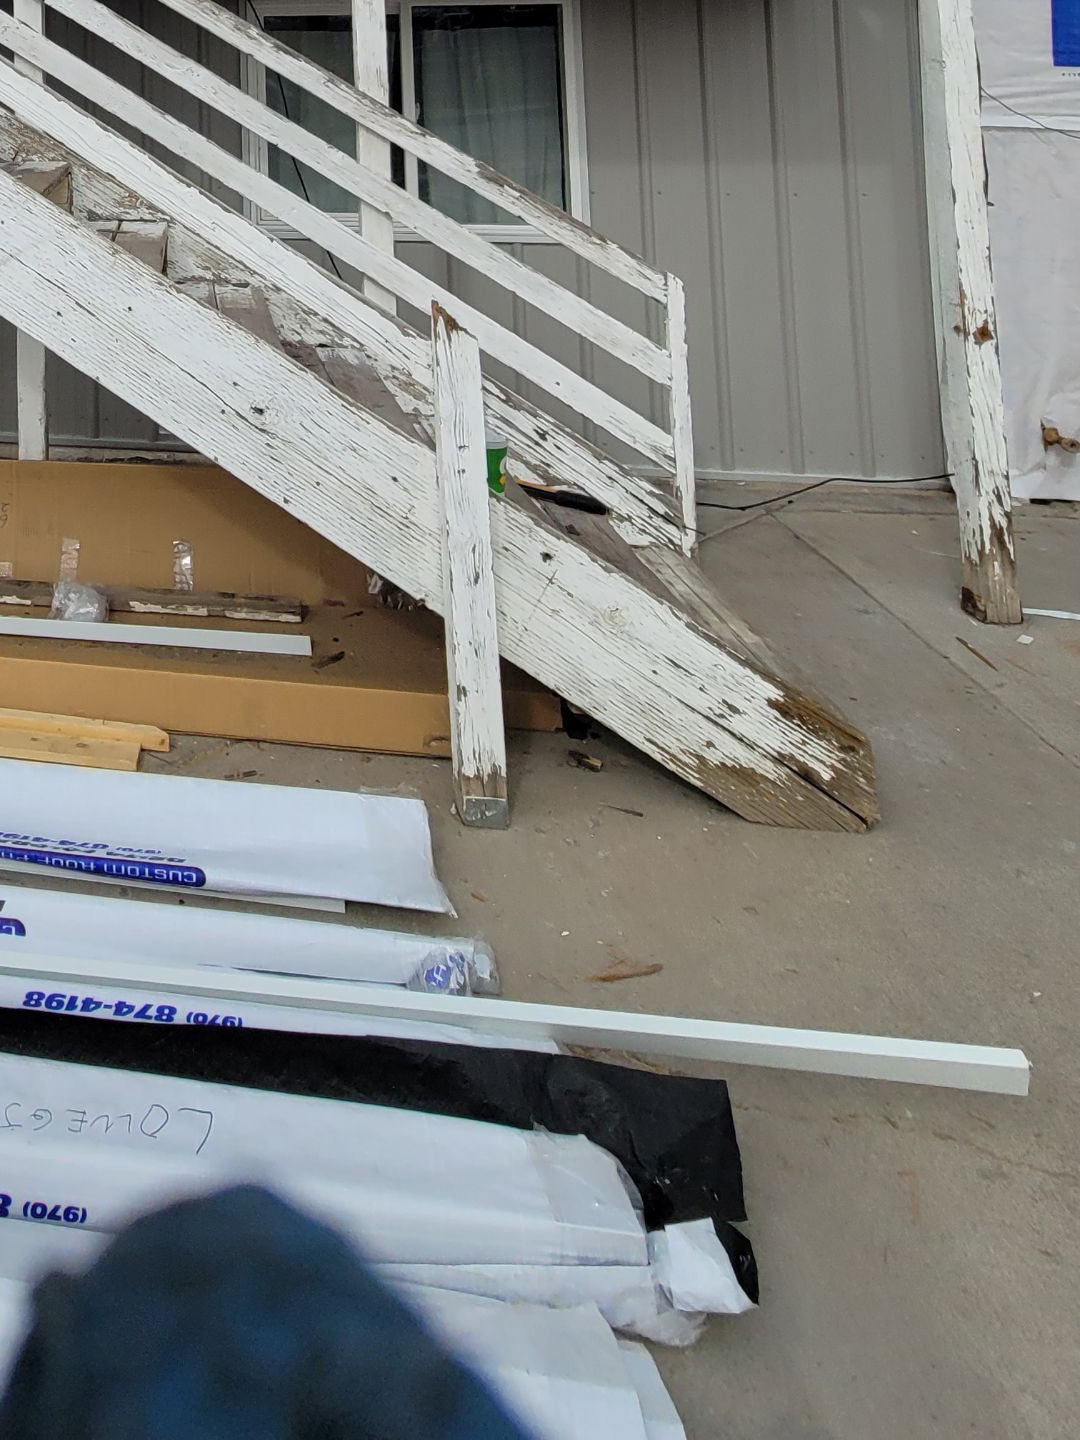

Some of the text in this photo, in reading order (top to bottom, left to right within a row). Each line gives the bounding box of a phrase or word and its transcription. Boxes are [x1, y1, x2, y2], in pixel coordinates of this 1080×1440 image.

[103, 863, 198, 884] CUSTOM
[22, 991, 243, 1028] (970) 874-4198
[22, 1201, 88, 1224] (970)
